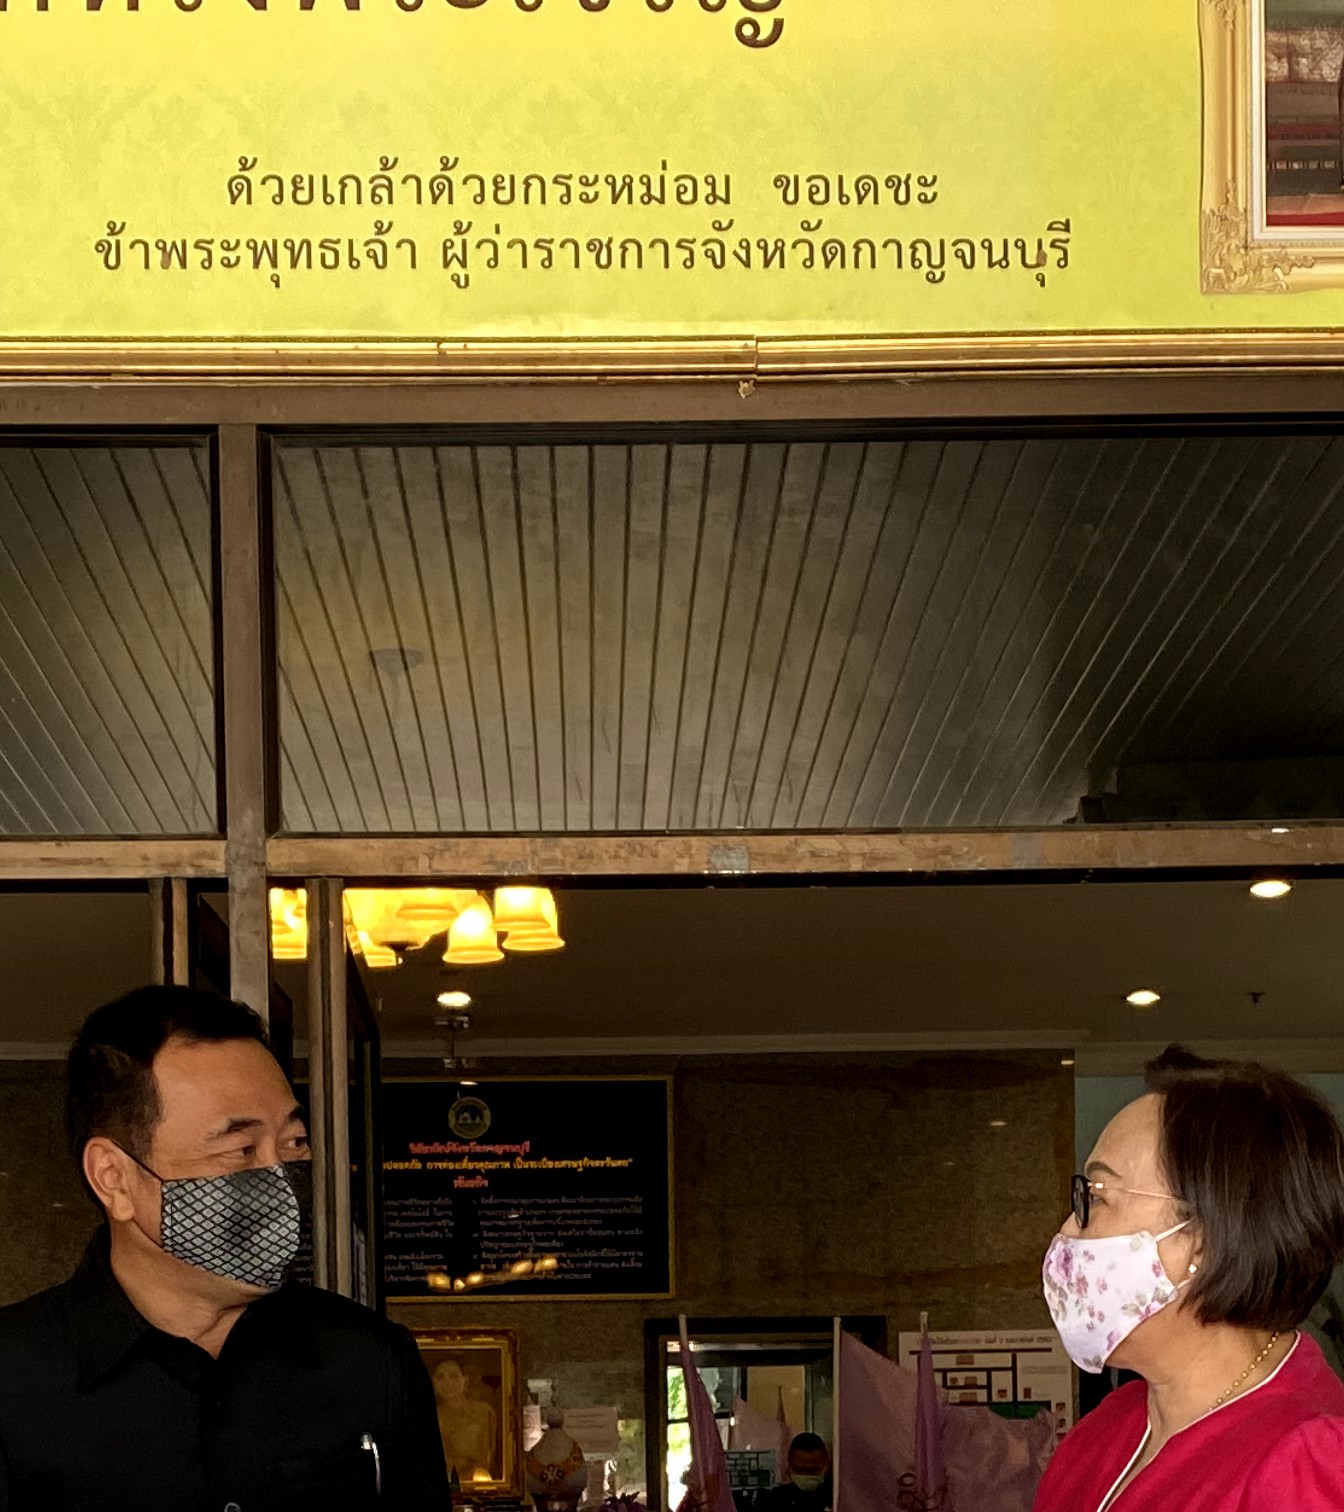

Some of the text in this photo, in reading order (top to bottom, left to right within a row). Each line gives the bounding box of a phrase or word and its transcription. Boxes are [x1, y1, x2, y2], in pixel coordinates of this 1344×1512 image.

[226, 154, 939, 208] ด้วยเกล้าด้วยกระหม่อม ขอเดชะ
[93, 217, 1072, 290] ข้าพระพุทธเจ้า ผู้ว่าราชการจังหวัดกาญจนบุรี
